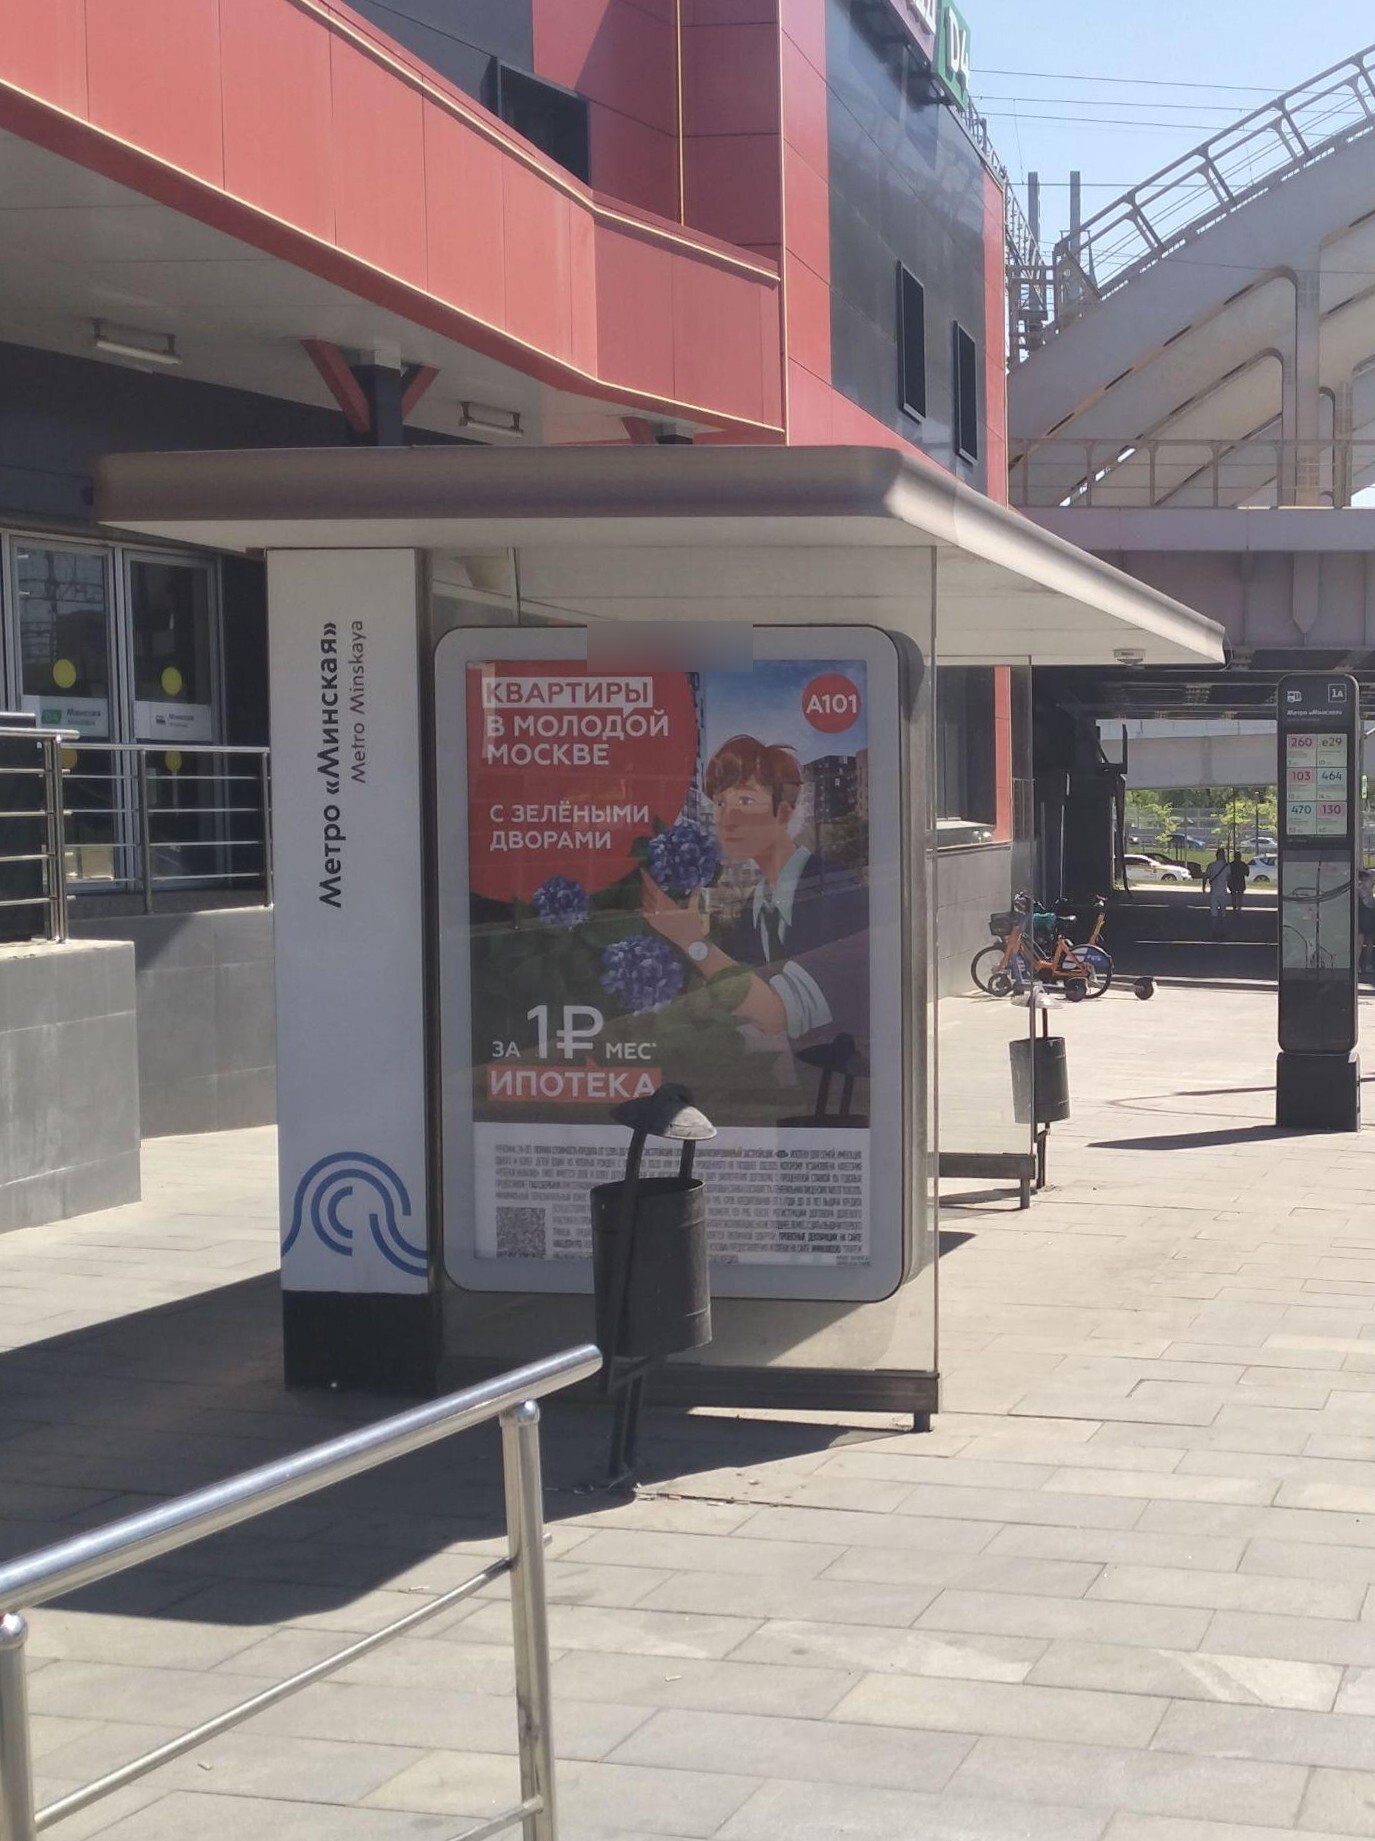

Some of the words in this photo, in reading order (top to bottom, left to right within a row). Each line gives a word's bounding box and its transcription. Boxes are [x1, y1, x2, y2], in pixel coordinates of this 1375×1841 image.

[348, 620, 367, 715] Minskaya
[487, 682, 649, 703] КВАРТИРЫ
[317, 622, 341, 796] «Минская»
[487, 716, 505, 737] В
[514, 709, 669, 741] МОЛОДОЙ
[1291, 737, 1313, 747] 260
[350, 722, 367, 784] Metro
[487, 743, 610, 765] МОСКВЕ
[1292, 771, 1311, 781] 103
[1322, 771, 1342, 781] 464
[490, 805, 504, 823] С
[511, 800, 649, 823] ЗЕЛЁНЫМИ
[1291, 804, 1312, 815] 470
[1323, 804, 1341, 815] 130
[490, 831, 611, 851] ДВОРАМИ
[319, 805, 346, 908] Метро
[492, 1041, 521, 1057] ЗА
[490, 1071, 656, 1098] ИПОТЕКА
